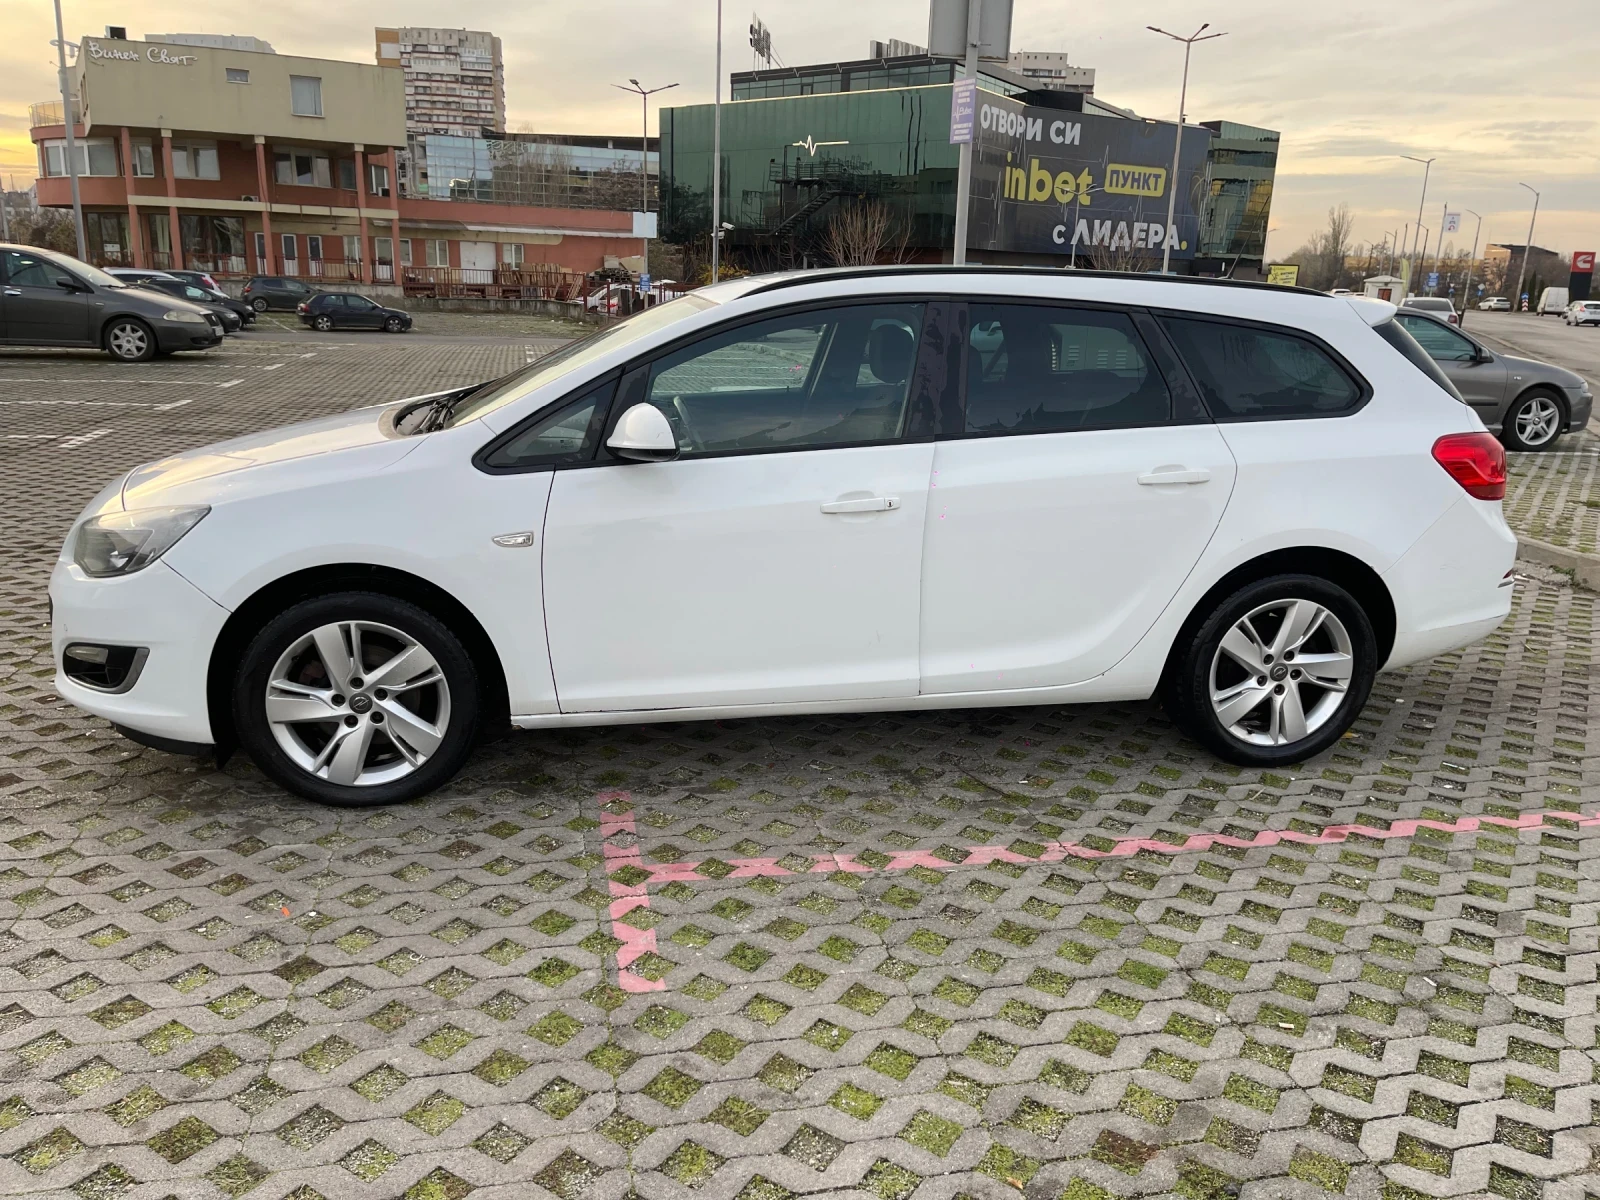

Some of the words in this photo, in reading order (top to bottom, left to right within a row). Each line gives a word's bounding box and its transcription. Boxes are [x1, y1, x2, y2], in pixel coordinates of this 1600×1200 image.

[88, 40, 140, 62] Винен
[146, 47, 198, 66] Свят
[980, 103, 1043, 142] ОТВОРИ
[1049, 120, 1082, 146] СИ
[1003, 151, 1093, 206] inbet
[1109, 169, 1162, 192] ПУНКТ
